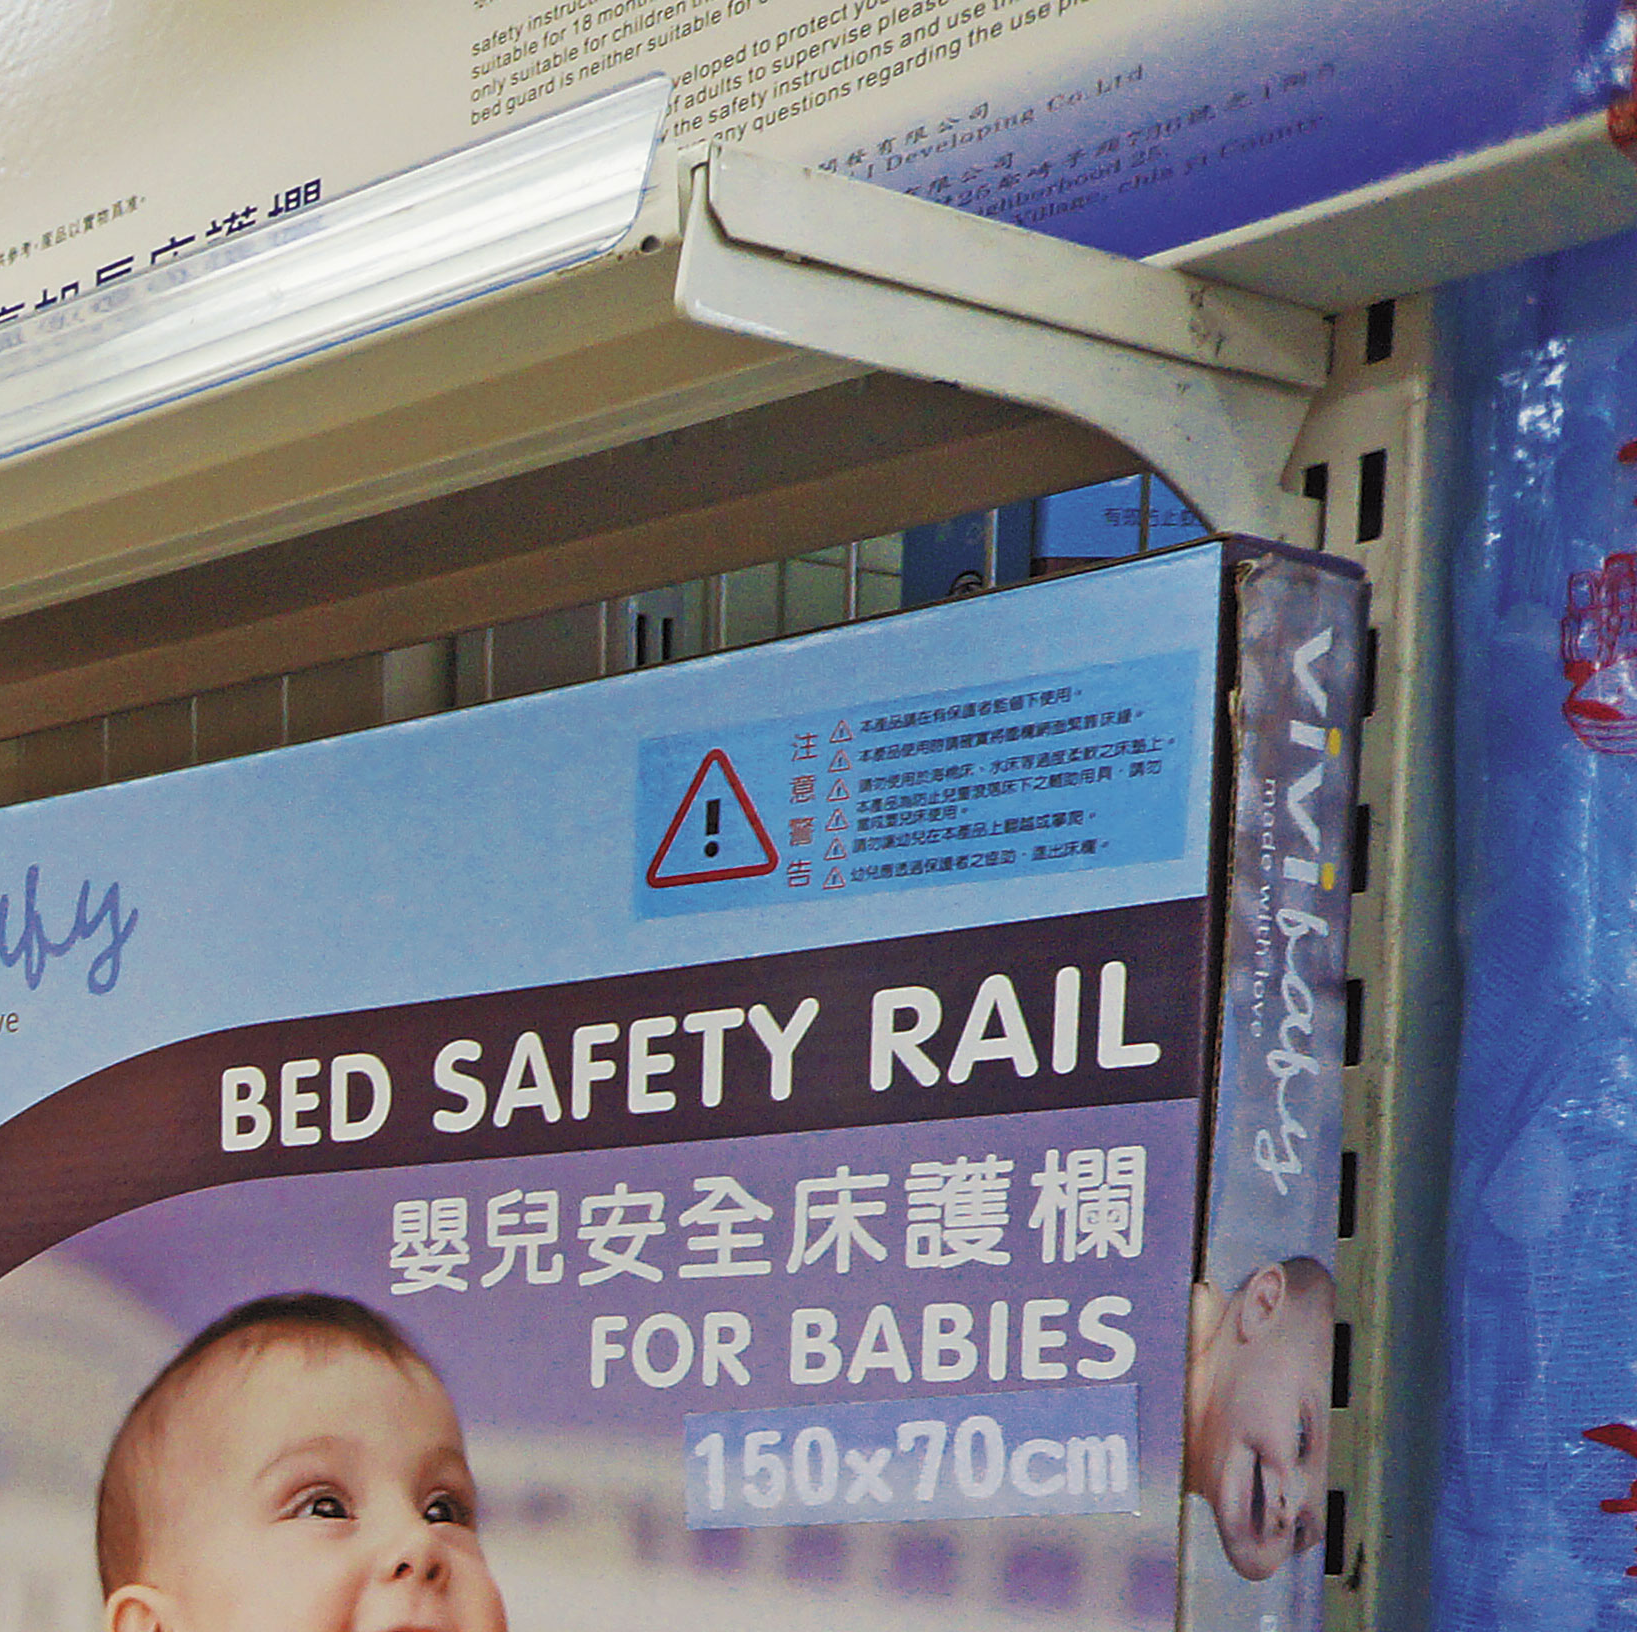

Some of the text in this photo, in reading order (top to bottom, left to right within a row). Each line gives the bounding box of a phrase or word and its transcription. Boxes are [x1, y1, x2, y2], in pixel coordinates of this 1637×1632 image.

[469, 102, 502, 126] bed
[505, 82, 555, 115] guard
[559, 68, 574, 90] is
[578, 43, 642, 81] neither
[646, 12, 723, 53] suitable
[470, 2, 681, 103] only suitable for children
[471, 25, 524, 57] safety
[471, 14, 592, 79] suitable for 18
[672, 5, 849, 92] veloped to protect
[673, 6, 985, 142] the safety instructions and use
[685, 73, 744, 111] adults
[747, 65, 766, 85] to
[772, 24, 873, 78] supervise
[751, 83, 852, 134] questions
[855, 36, 963, 91] regarding
[966, 18, 1005, 48] the
[1010, 3, 1053, 32] use
[885, 108, 1036, 176] Developing
[786, 730, 820, 889] 注意警告
[1253, 625, 1343, 1198] vivibaby
[219, 959, 1161, 1154] BED SAFETY RAIL
[387, 1143, 1149, 1297] 嬰兒安全床護欄
[588, 1294, 1137, 1391] FOR BABIES
[691, 1414, 1131, 1514] 150x70cm
